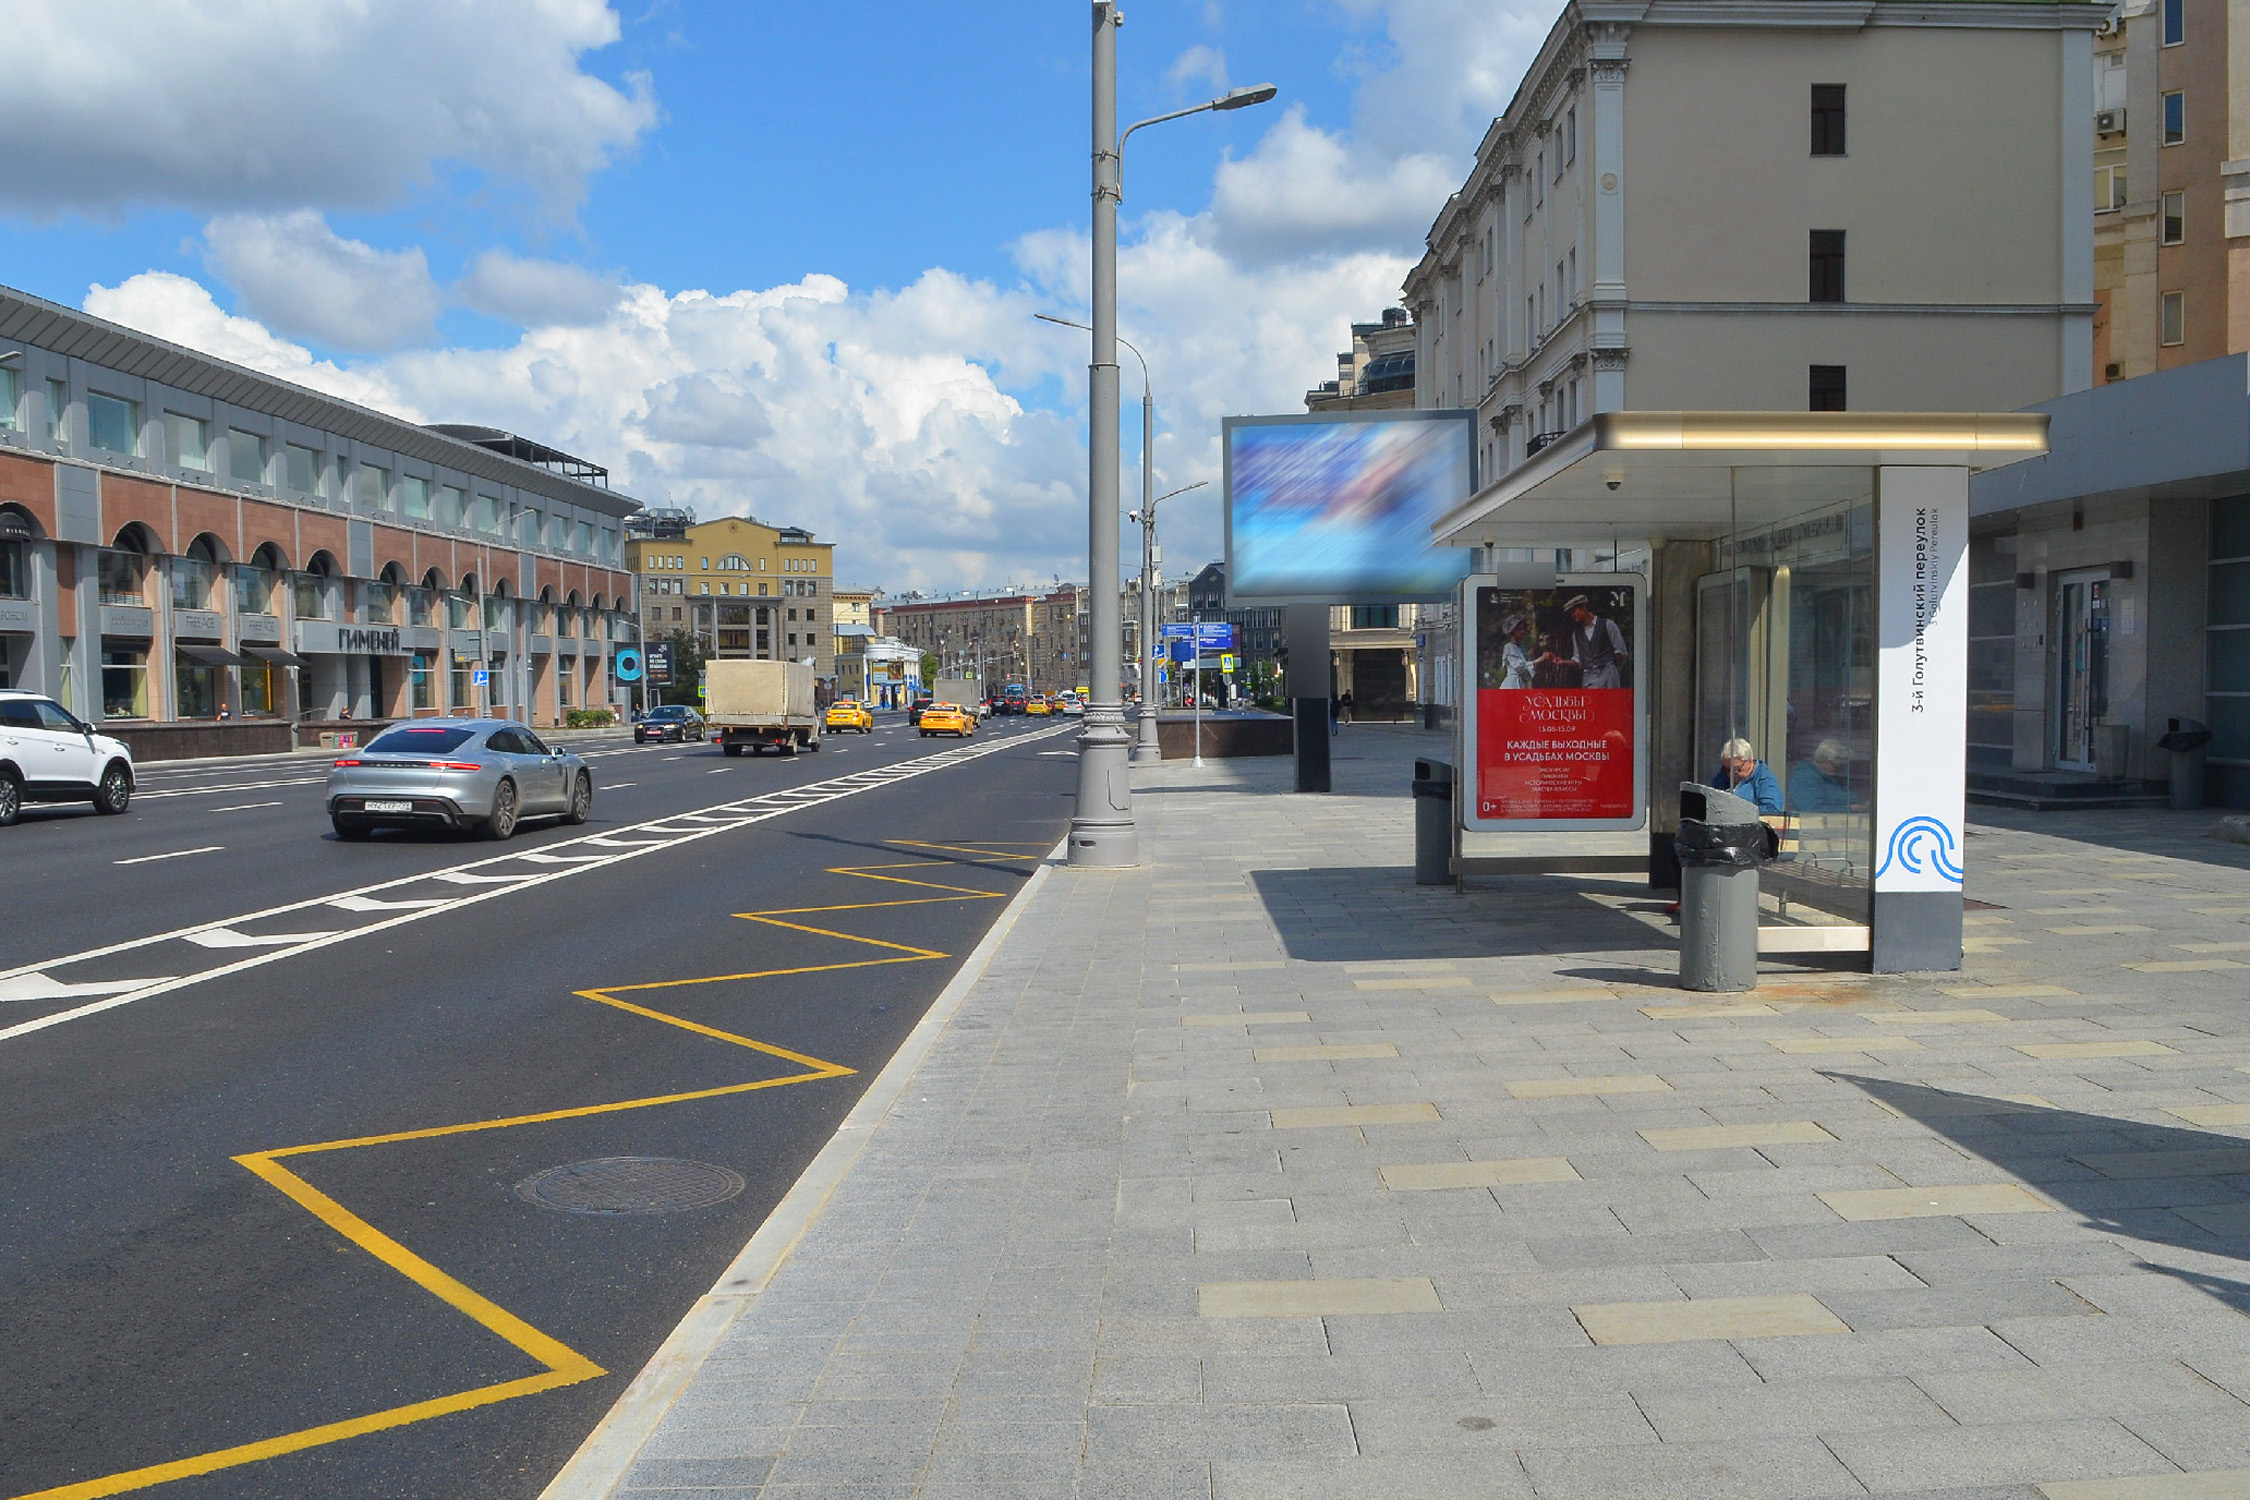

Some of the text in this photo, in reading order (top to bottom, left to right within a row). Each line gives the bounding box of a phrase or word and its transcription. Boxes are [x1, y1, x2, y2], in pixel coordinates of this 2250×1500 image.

[1929, 508, 1939, 553] Pereulok
[1915, 508, 1928, 580] переулок
[1912, 583, 1928, 686] Голутвинский
[1522, 693, 1592, 711] УСАДЬБЫ
[1518, 709, 1595, 724] МОСКВЫ
[1507, 739, 1608, 750] КАЖДЫЕ ВЫХОДНЫЕ
[1504, 752, 1610, 762] В УСАДЬБАХ МОСКВЫ
[1483, 801, 1497, 812] 0+
